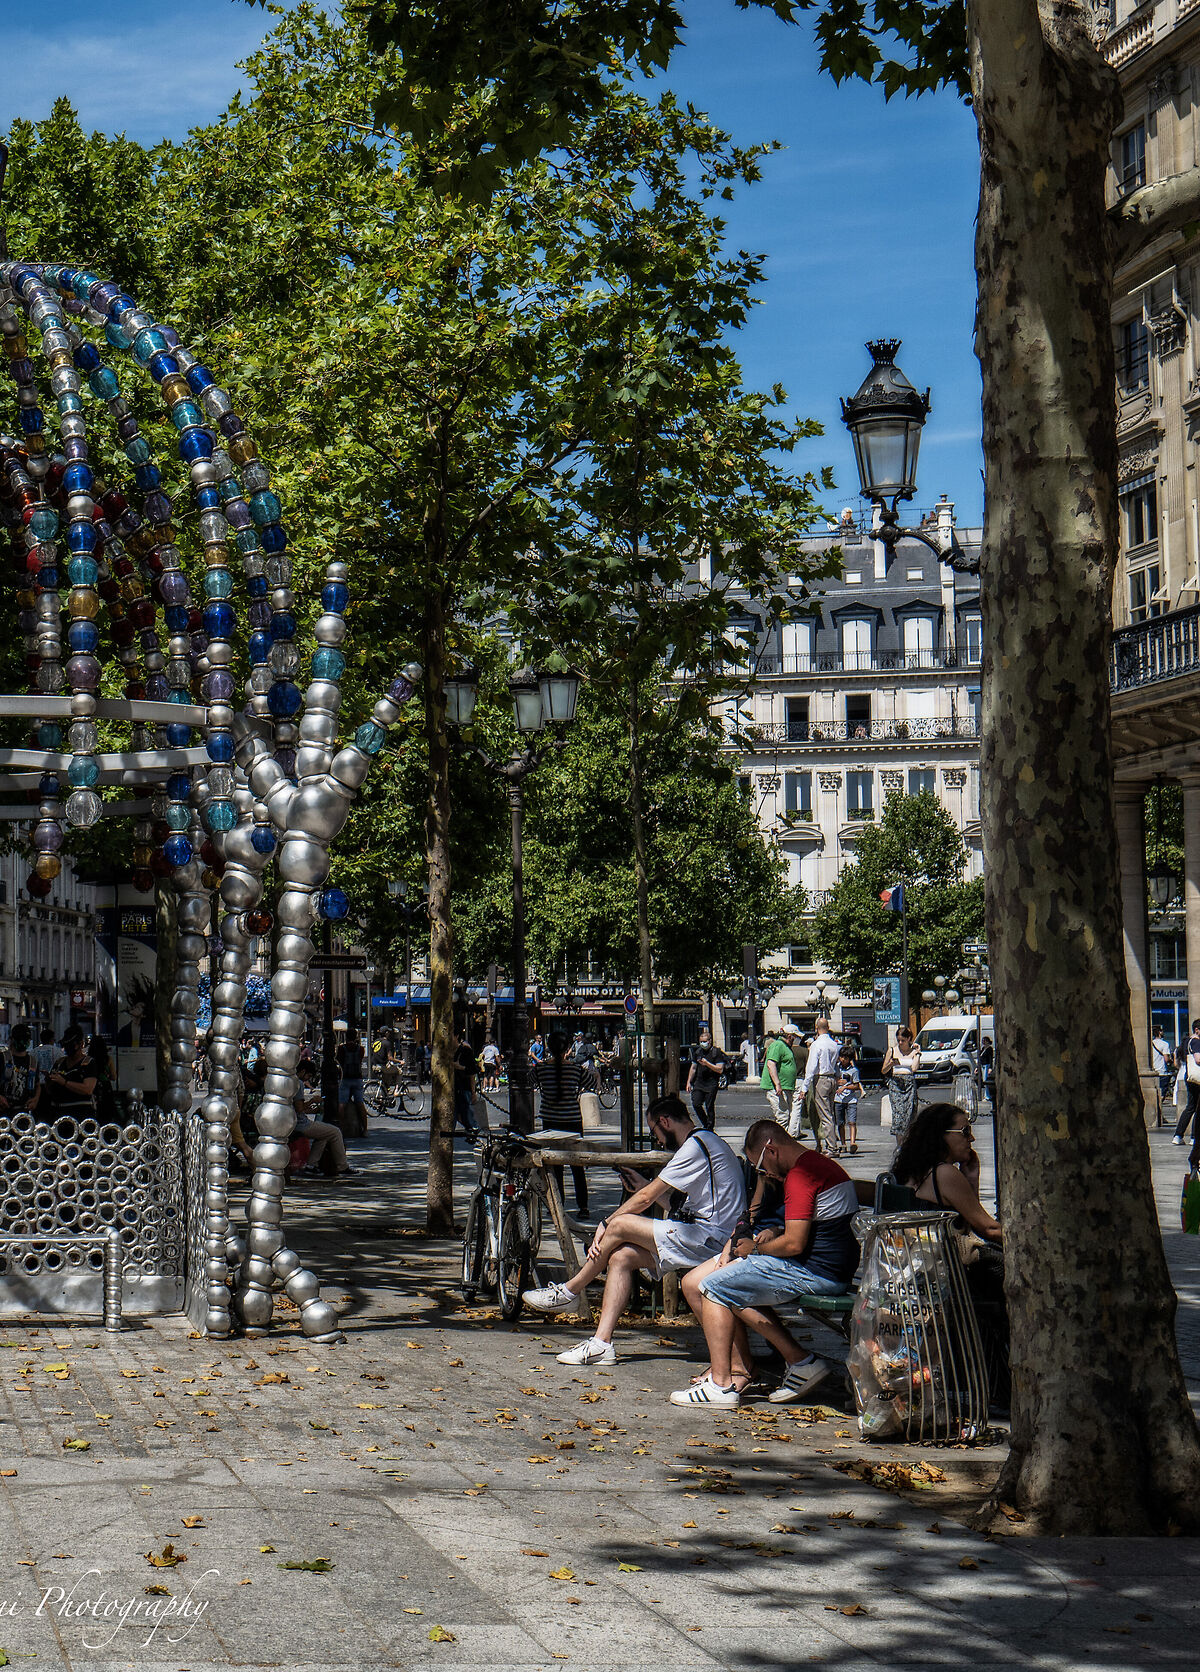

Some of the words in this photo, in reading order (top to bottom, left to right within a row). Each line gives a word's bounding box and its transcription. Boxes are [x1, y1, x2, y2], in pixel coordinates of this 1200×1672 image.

[121, 914, 153, 925] PARIS
[601, 986, 612, 996] of
[1156, 989, 1186, 998] Mutuel
